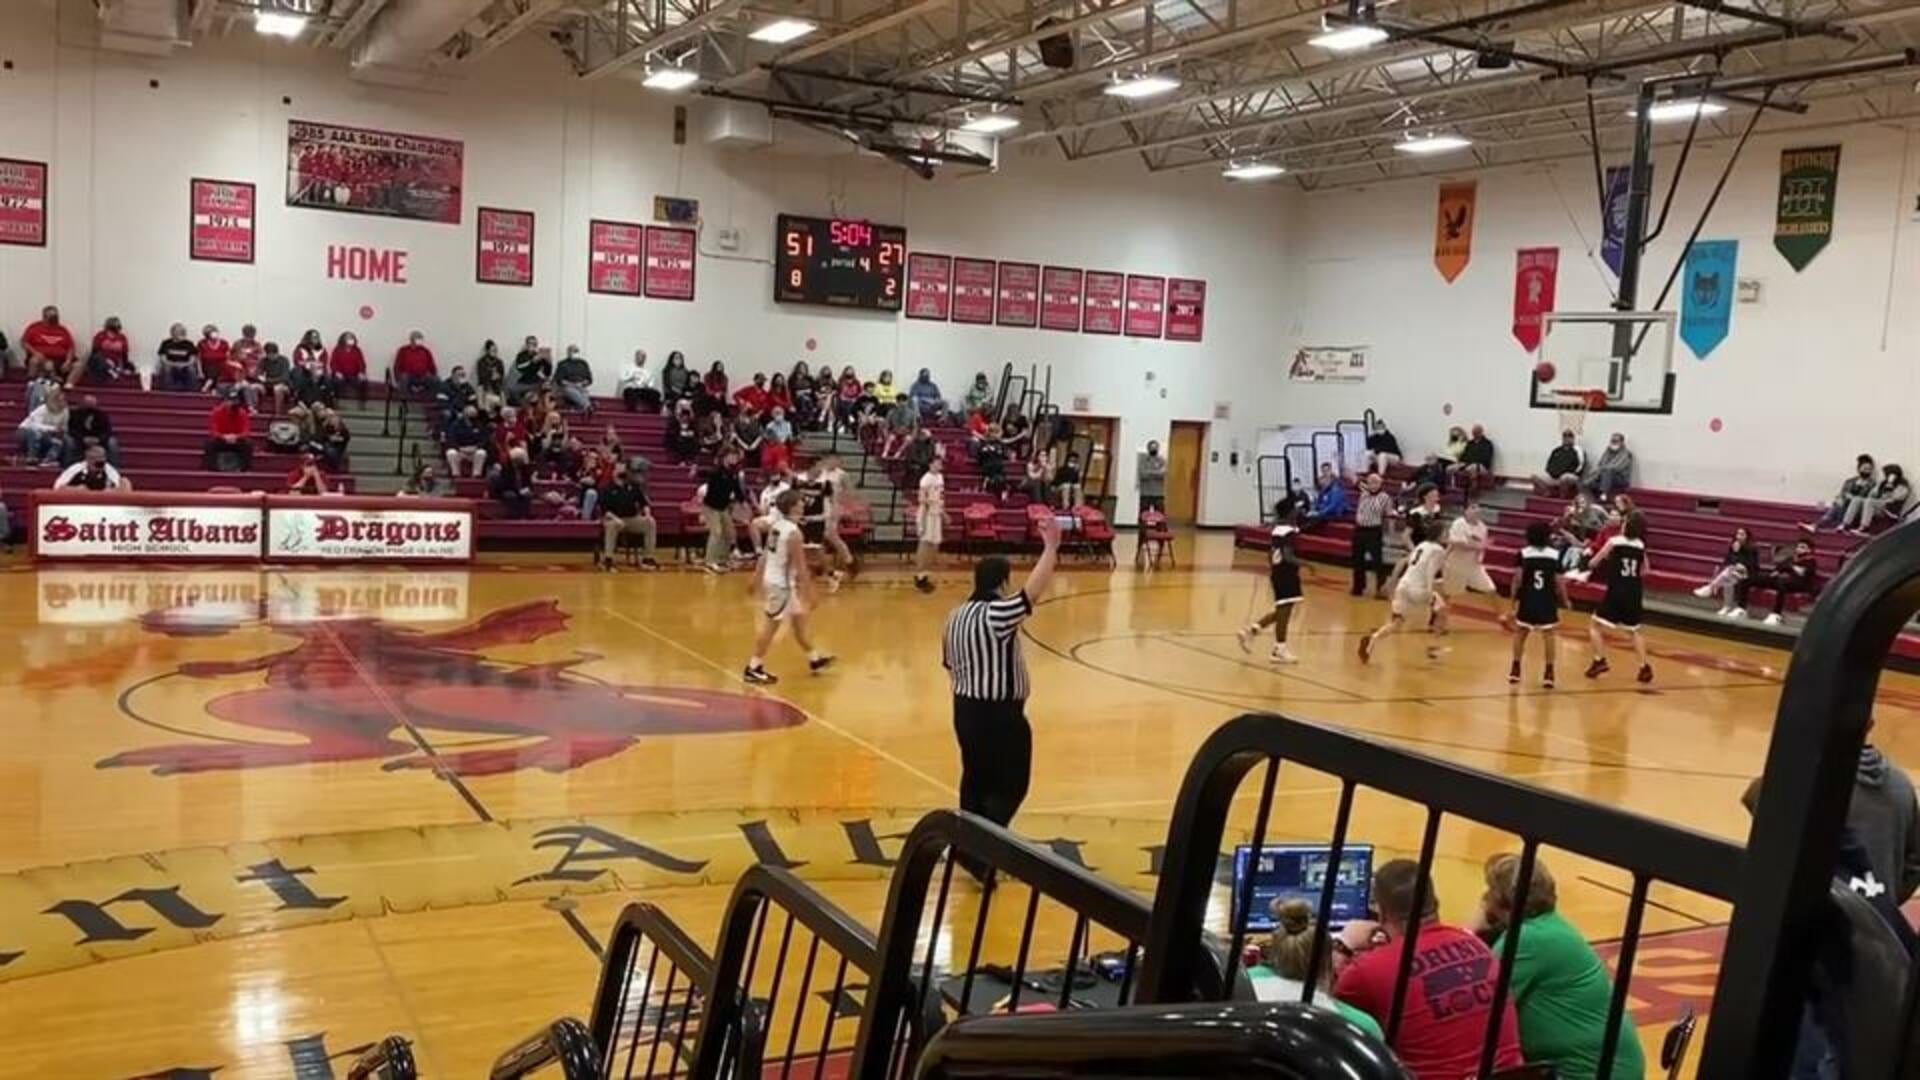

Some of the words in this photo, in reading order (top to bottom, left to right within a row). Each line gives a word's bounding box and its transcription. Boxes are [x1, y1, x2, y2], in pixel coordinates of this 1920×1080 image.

[331, 130, 355, 144] AAA
[360, 134, 391, 148] State
[831, 221, 872, 246] 5:04
[786, 232, 813, 257] 51
[879, 242, 904, 265] 27
[327, 245, 407, 284] HOME
[859, 257, 871, 272] 4
[790, 269, 802, 287] 8
[885, 278, 897, 296] 2
[43, 515, 139, 543] Saint
[147, 516, 258, 543] Albans
[315, 513, 461, 546] Dragons
[112, 544, 142, 552] HIGH
[145, 544, 191, 552] SCHOOL
[1533, 570, 1545, 590] 5
